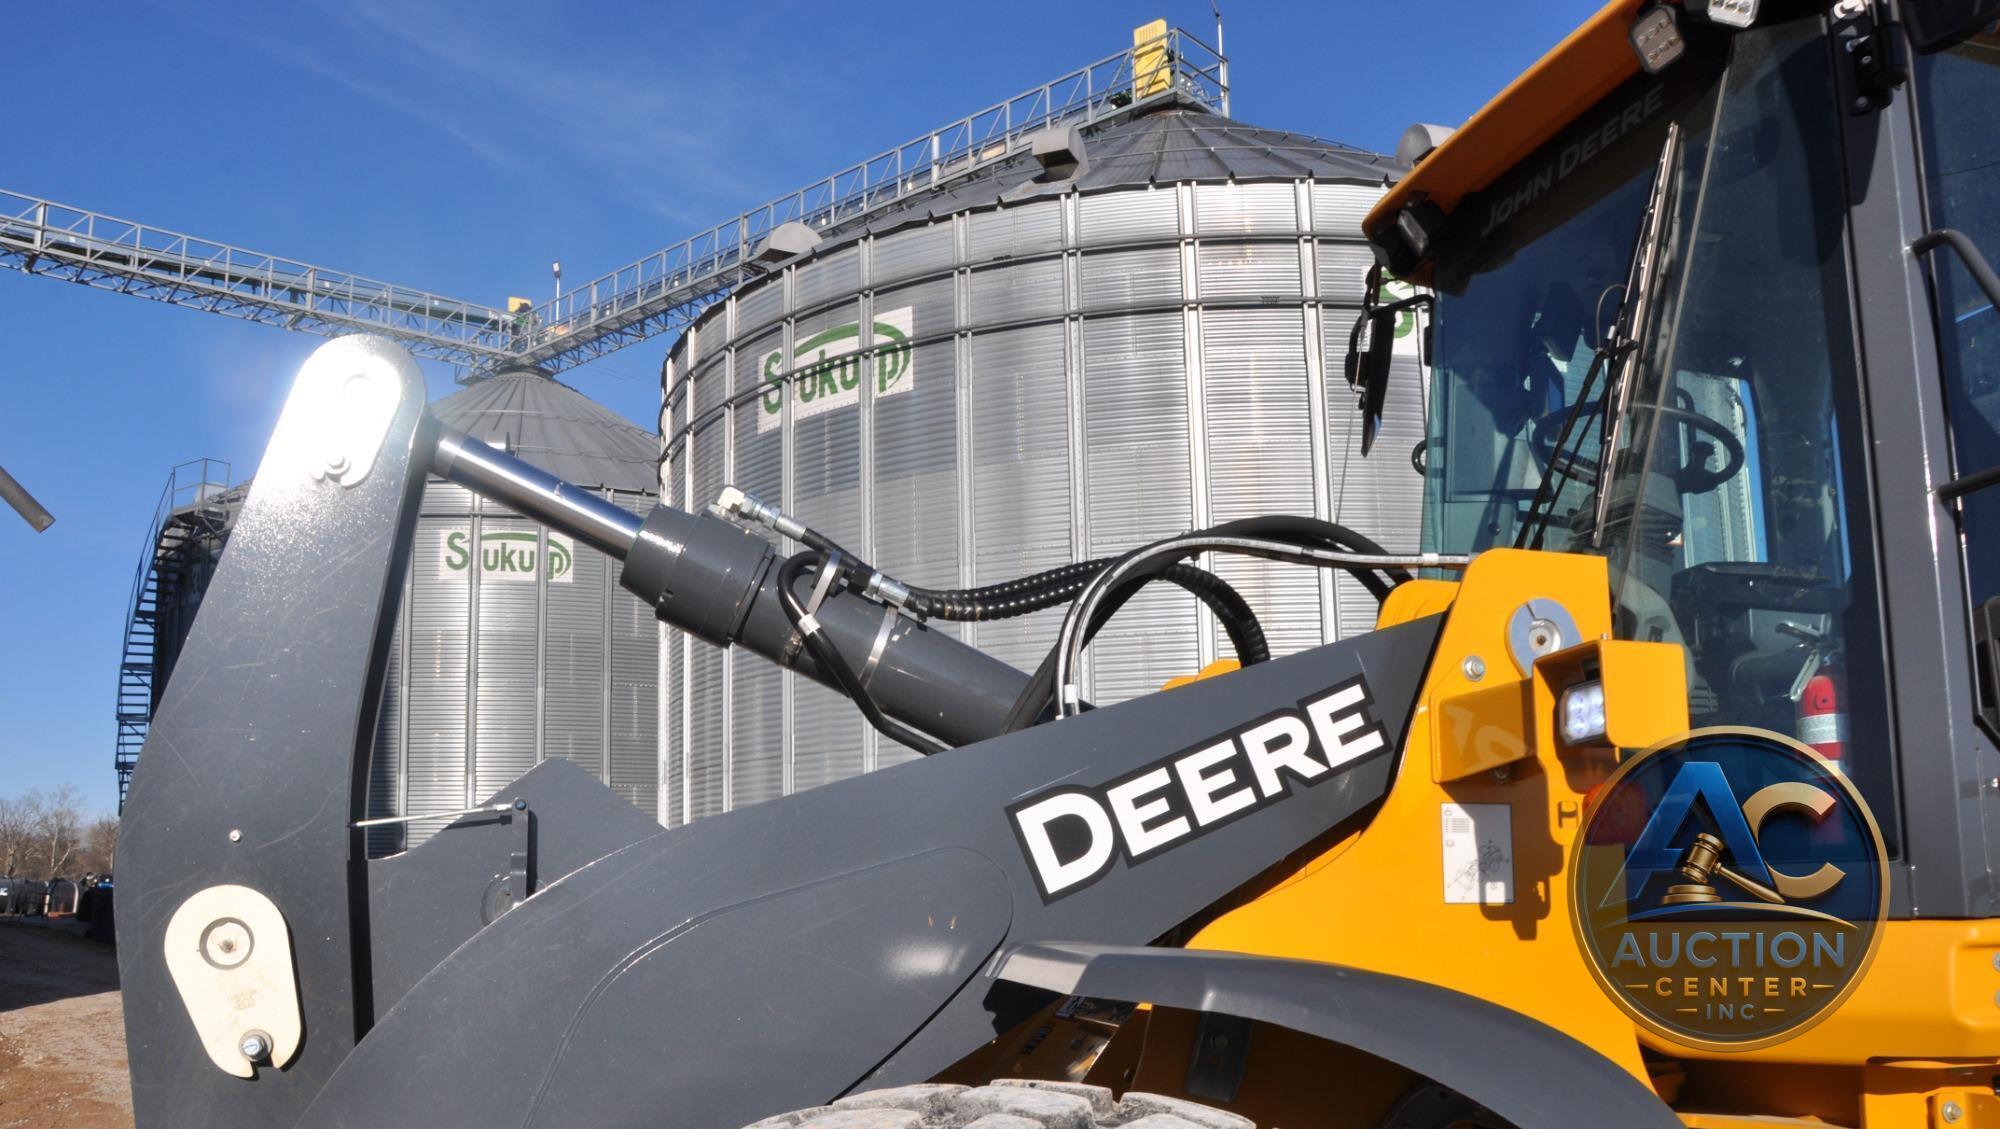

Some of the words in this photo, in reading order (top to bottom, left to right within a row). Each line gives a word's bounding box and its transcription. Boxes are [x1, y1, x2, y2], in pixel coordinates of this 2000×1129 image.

[1480, 166, 1553, 238] JOHN
[1558, 82, 1665, 180] DEERE
[445, 531, 572, 579] Sukup
[1015, 683, 1385, 895] DEERE
